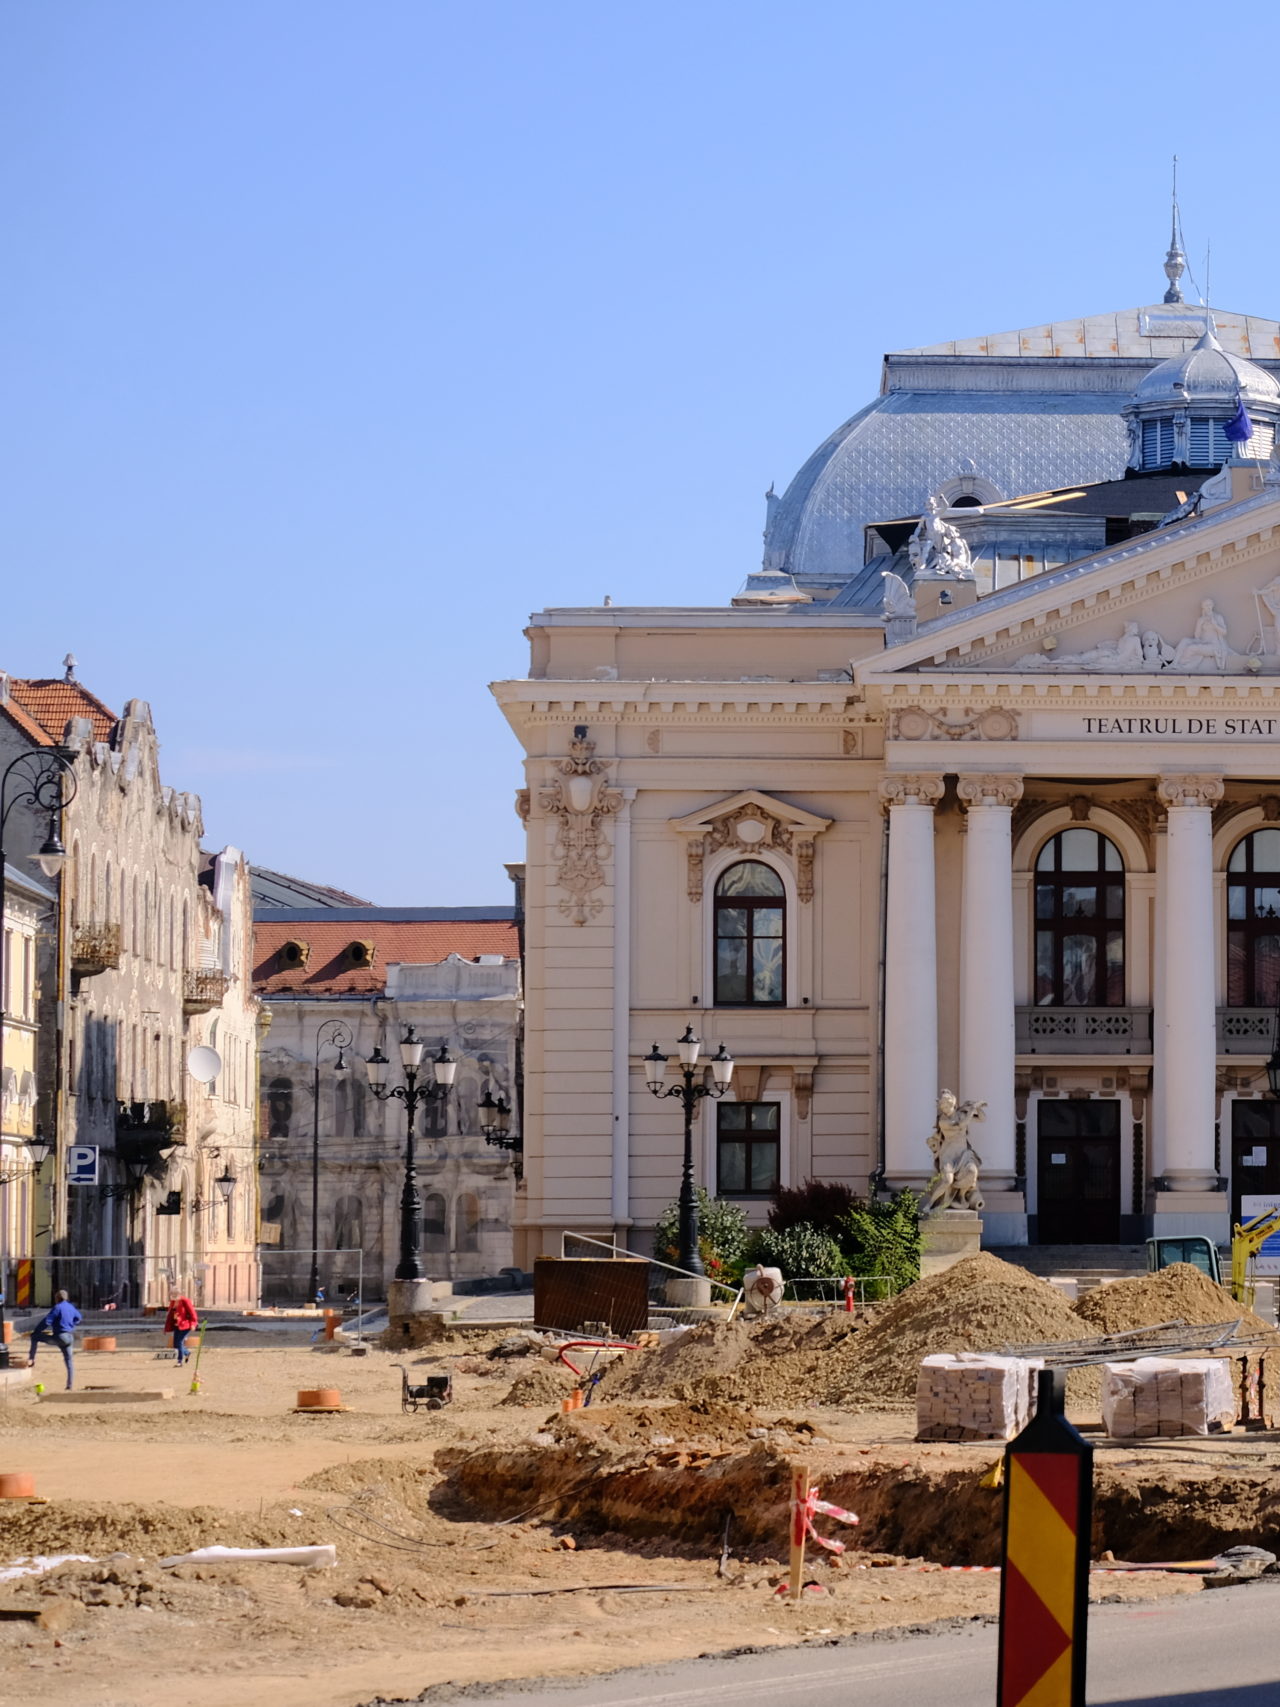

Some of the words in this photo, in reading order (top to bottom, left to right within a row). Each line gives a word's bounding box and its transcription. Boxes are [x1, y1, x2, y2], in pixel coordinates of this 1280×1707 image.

[1082, 717, 1182, 734] TEATRUL
[1187, 718, 1217, 735] DE
[1224, 718, 1277, 735] STAT
[70, 1147, 96, 1174] P
